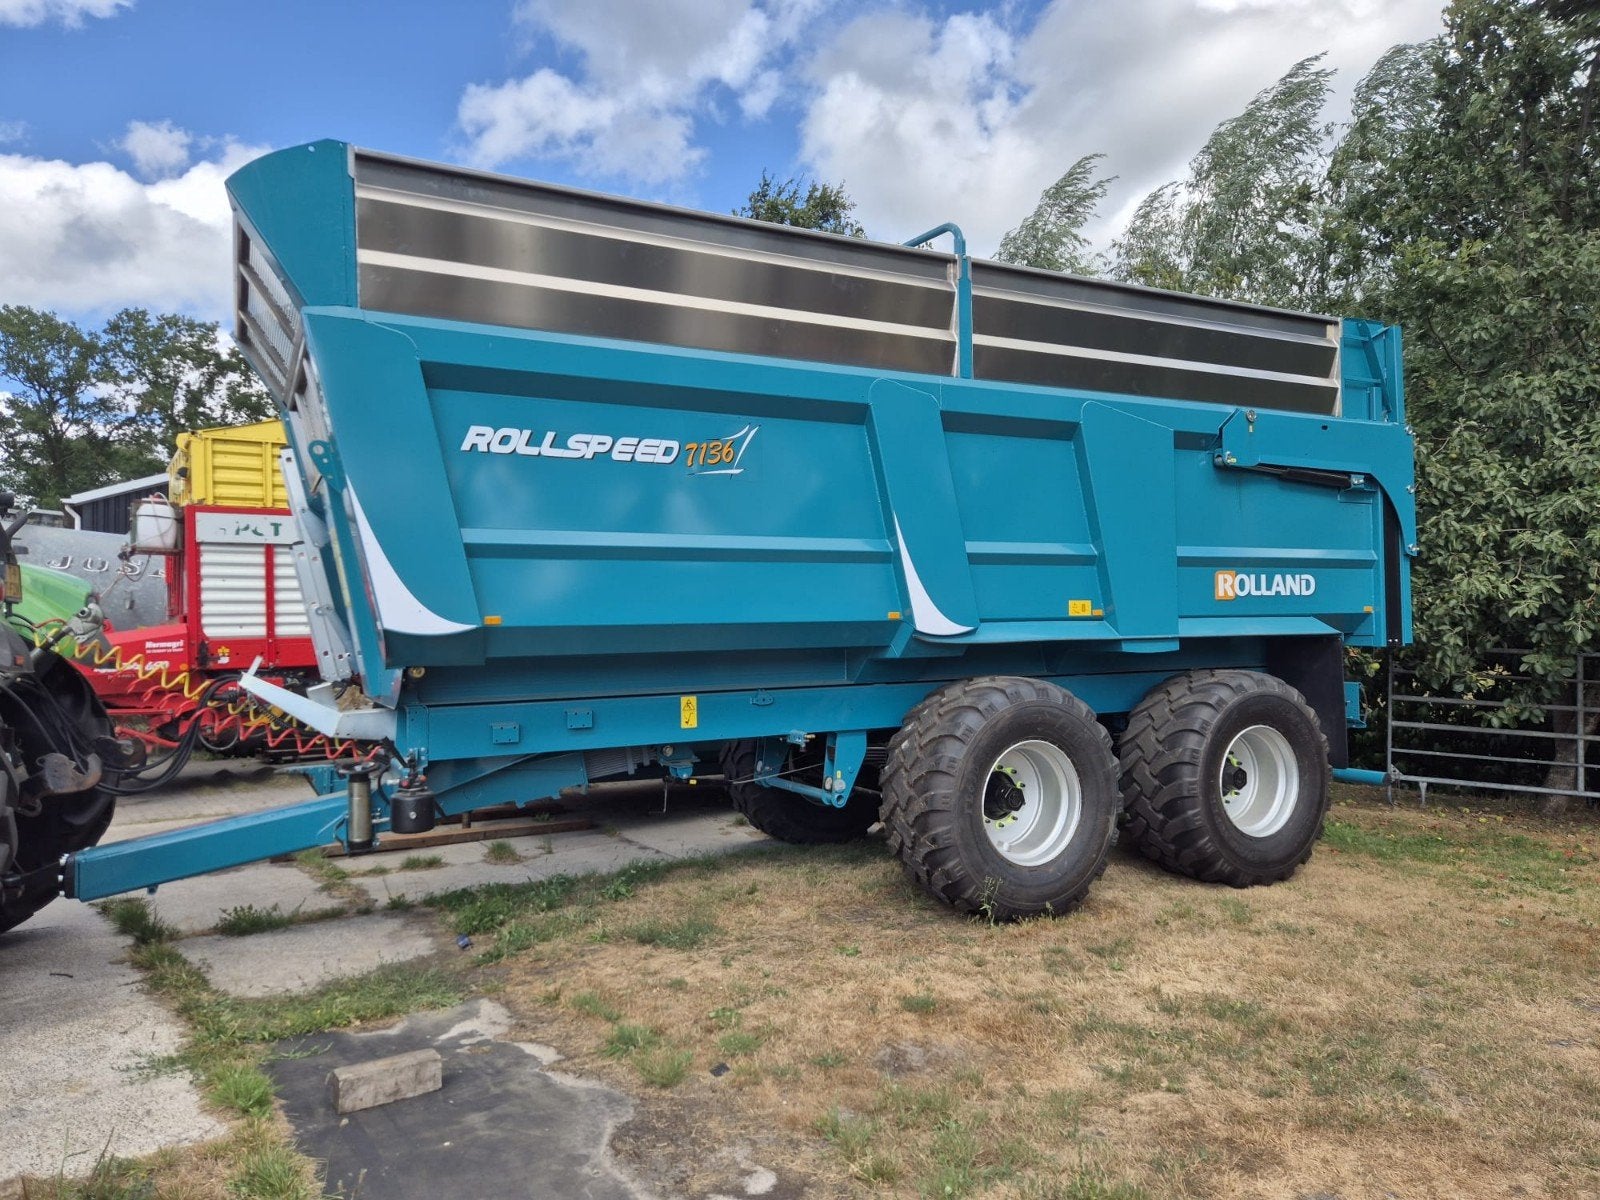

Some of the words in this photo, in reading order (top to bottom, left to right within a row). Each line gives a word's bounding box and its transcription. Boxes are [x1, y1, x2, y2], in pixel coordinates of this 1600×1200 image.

[460, 424, 681, 464] ROLLSPEED
[684, 439, 735, 467] 7136
[1217, 573, 1316, 597] ROLLAND
